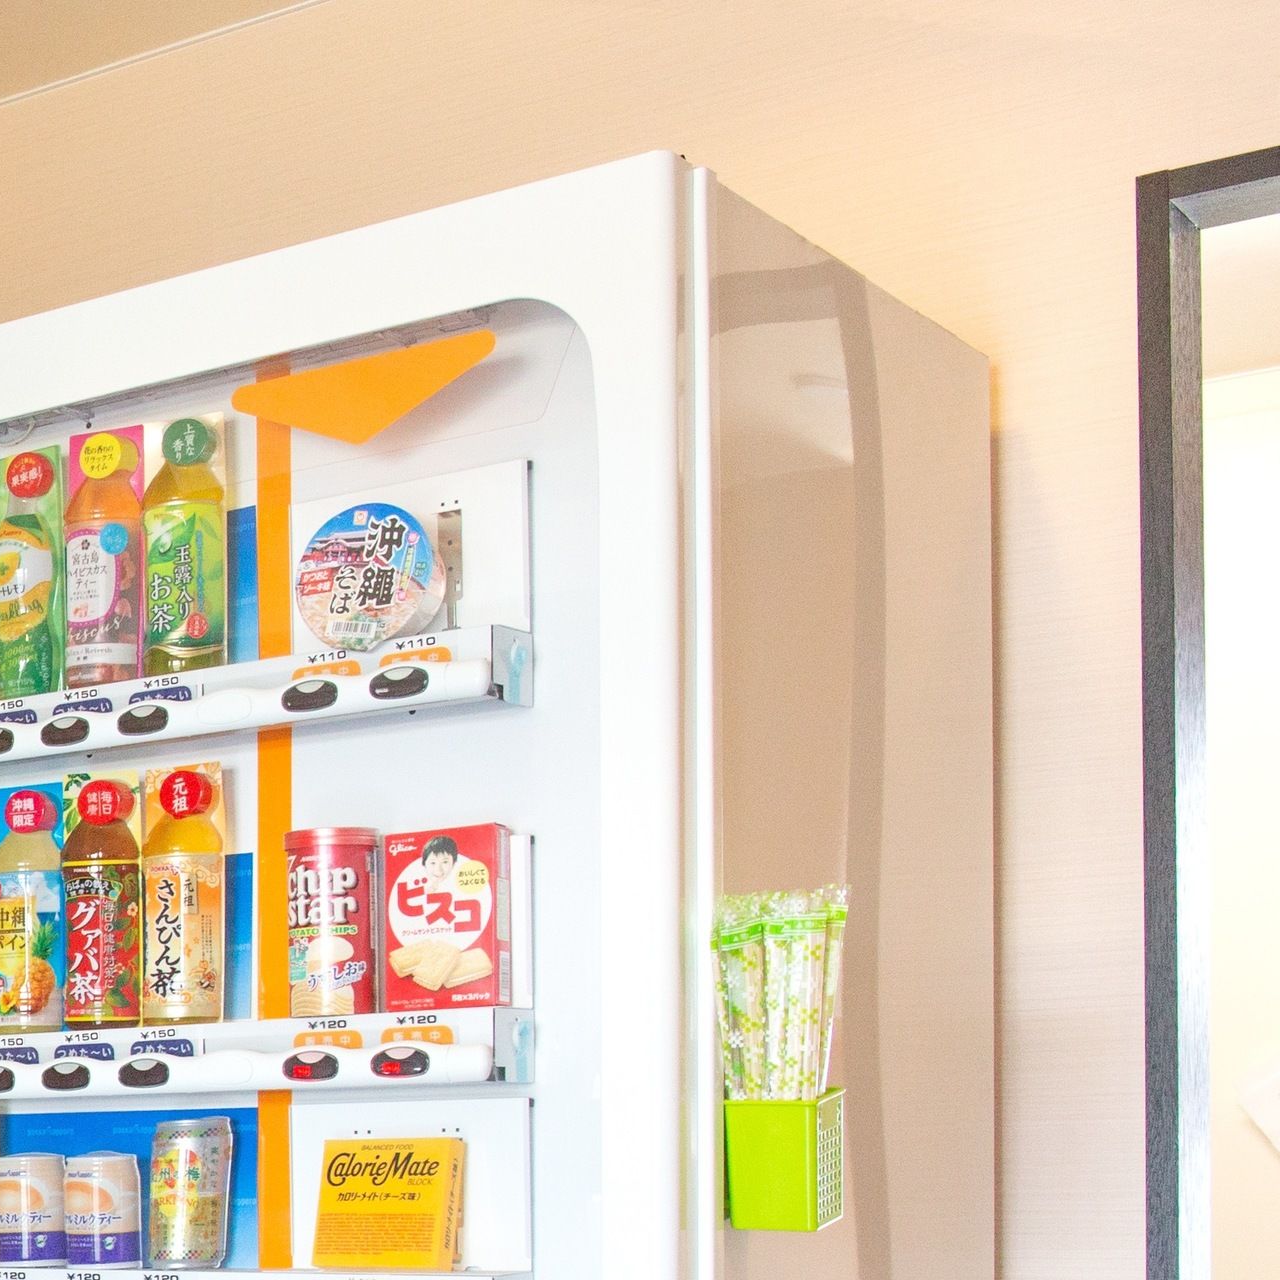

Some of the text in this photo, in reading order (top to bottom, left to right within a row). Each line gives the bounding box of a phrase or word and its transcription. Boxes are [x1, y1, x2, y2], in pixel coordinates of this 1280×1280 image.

[72, 550, 100, 566] 宮古島
[75, 579, 97, 590] ティー
[174, 544, 193, 620] 玉露入り
[329, 566, 357, 614] そば
[150, 574, 176, 634] お茶
[396, 636, 437, 651] ¥110
[308, 650, 347, 664] ¥110
[143, 676, 180, 689] ¥150
[64, 689, 98, 701] ¥150
[171, 777, 189, 813] 元祖
[11, 797, 35, 811] 沖縄
[86, 790, 99, 816] 健康
[100, 790, 113, 816] 毎日
[12, 814, 35, 827] 限定
[458, 868, 485, 878] おいしくて
[458, 878, 486, 887] つよくなる
[288, 894, 358, 926] star
[397, 878, 482, 933] ビスコ
[149, 878, 183, 998] さんぴん茶
[69, 899, 103, 1005] グァバ茶
[308, 1019, 348, 1030] ¥120
[396, 1014, 437, 1025] ¥120
[64, 1032, 99, 1042] ¥150
[140, 1028, 176, 1039] ¥150
[361, 1143, 394, 1151] BALANCED
[327, 1152, 440, 1187] CalorieMate
[407, 1177, 433, 1186] BLOCK
